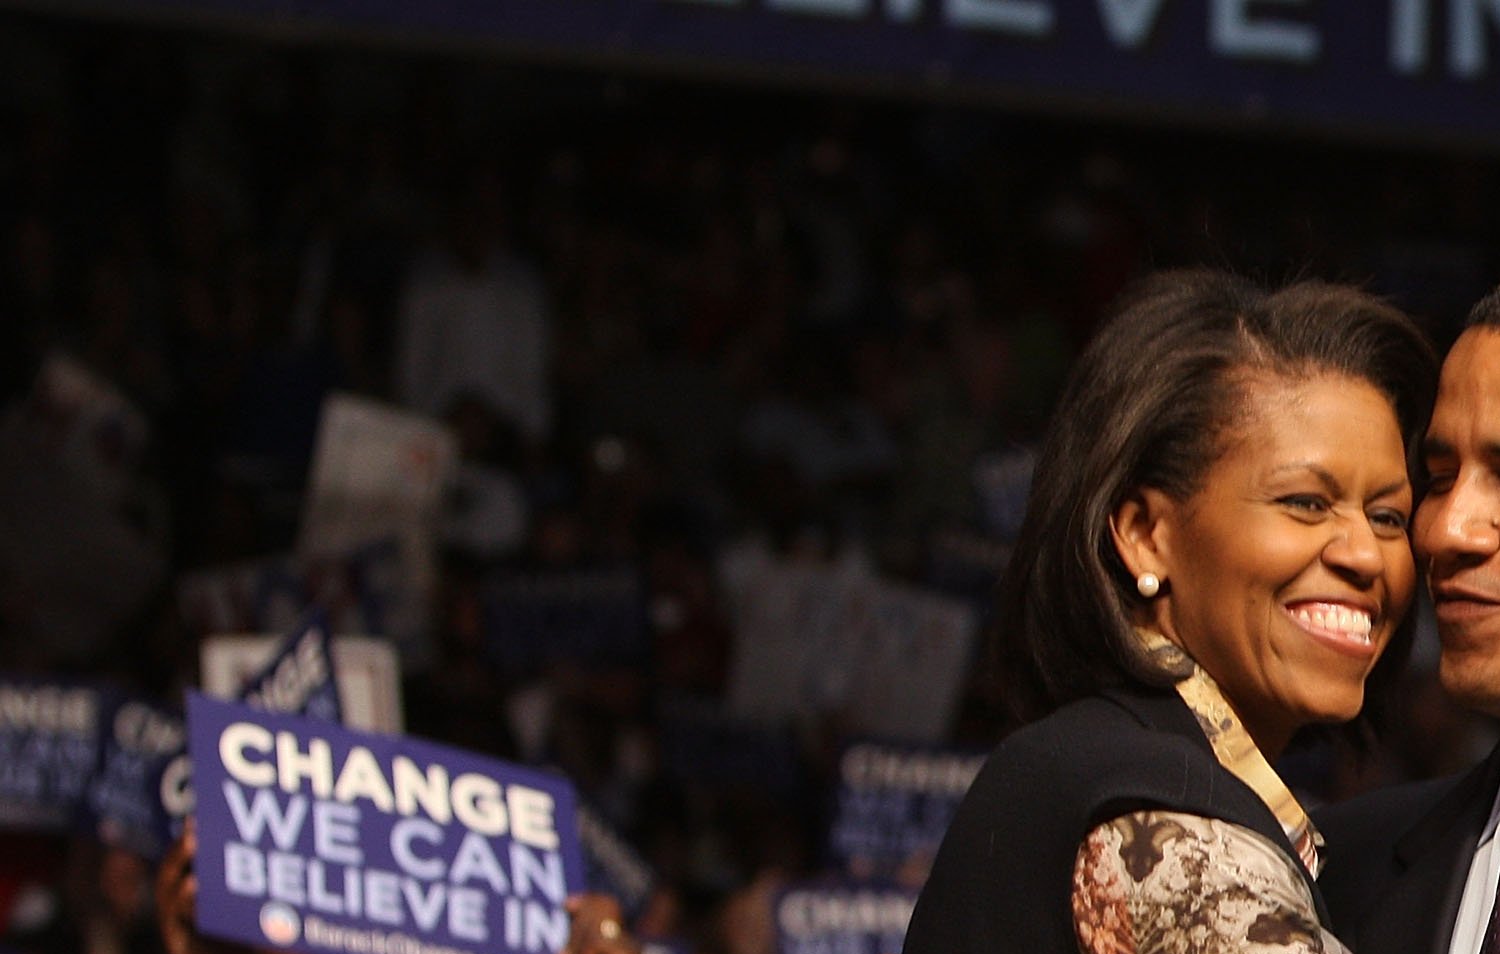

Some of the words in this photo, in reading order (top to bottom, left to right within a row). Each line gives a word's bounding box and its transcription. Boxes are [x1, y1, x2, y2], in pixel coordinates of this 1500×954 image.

[219, 722, 560, 851] CHANGE
[222, 780, 364, 866] WE
[389, 816, 568, 907] CAN
[223, 841, 490, 942] BELIEVE
